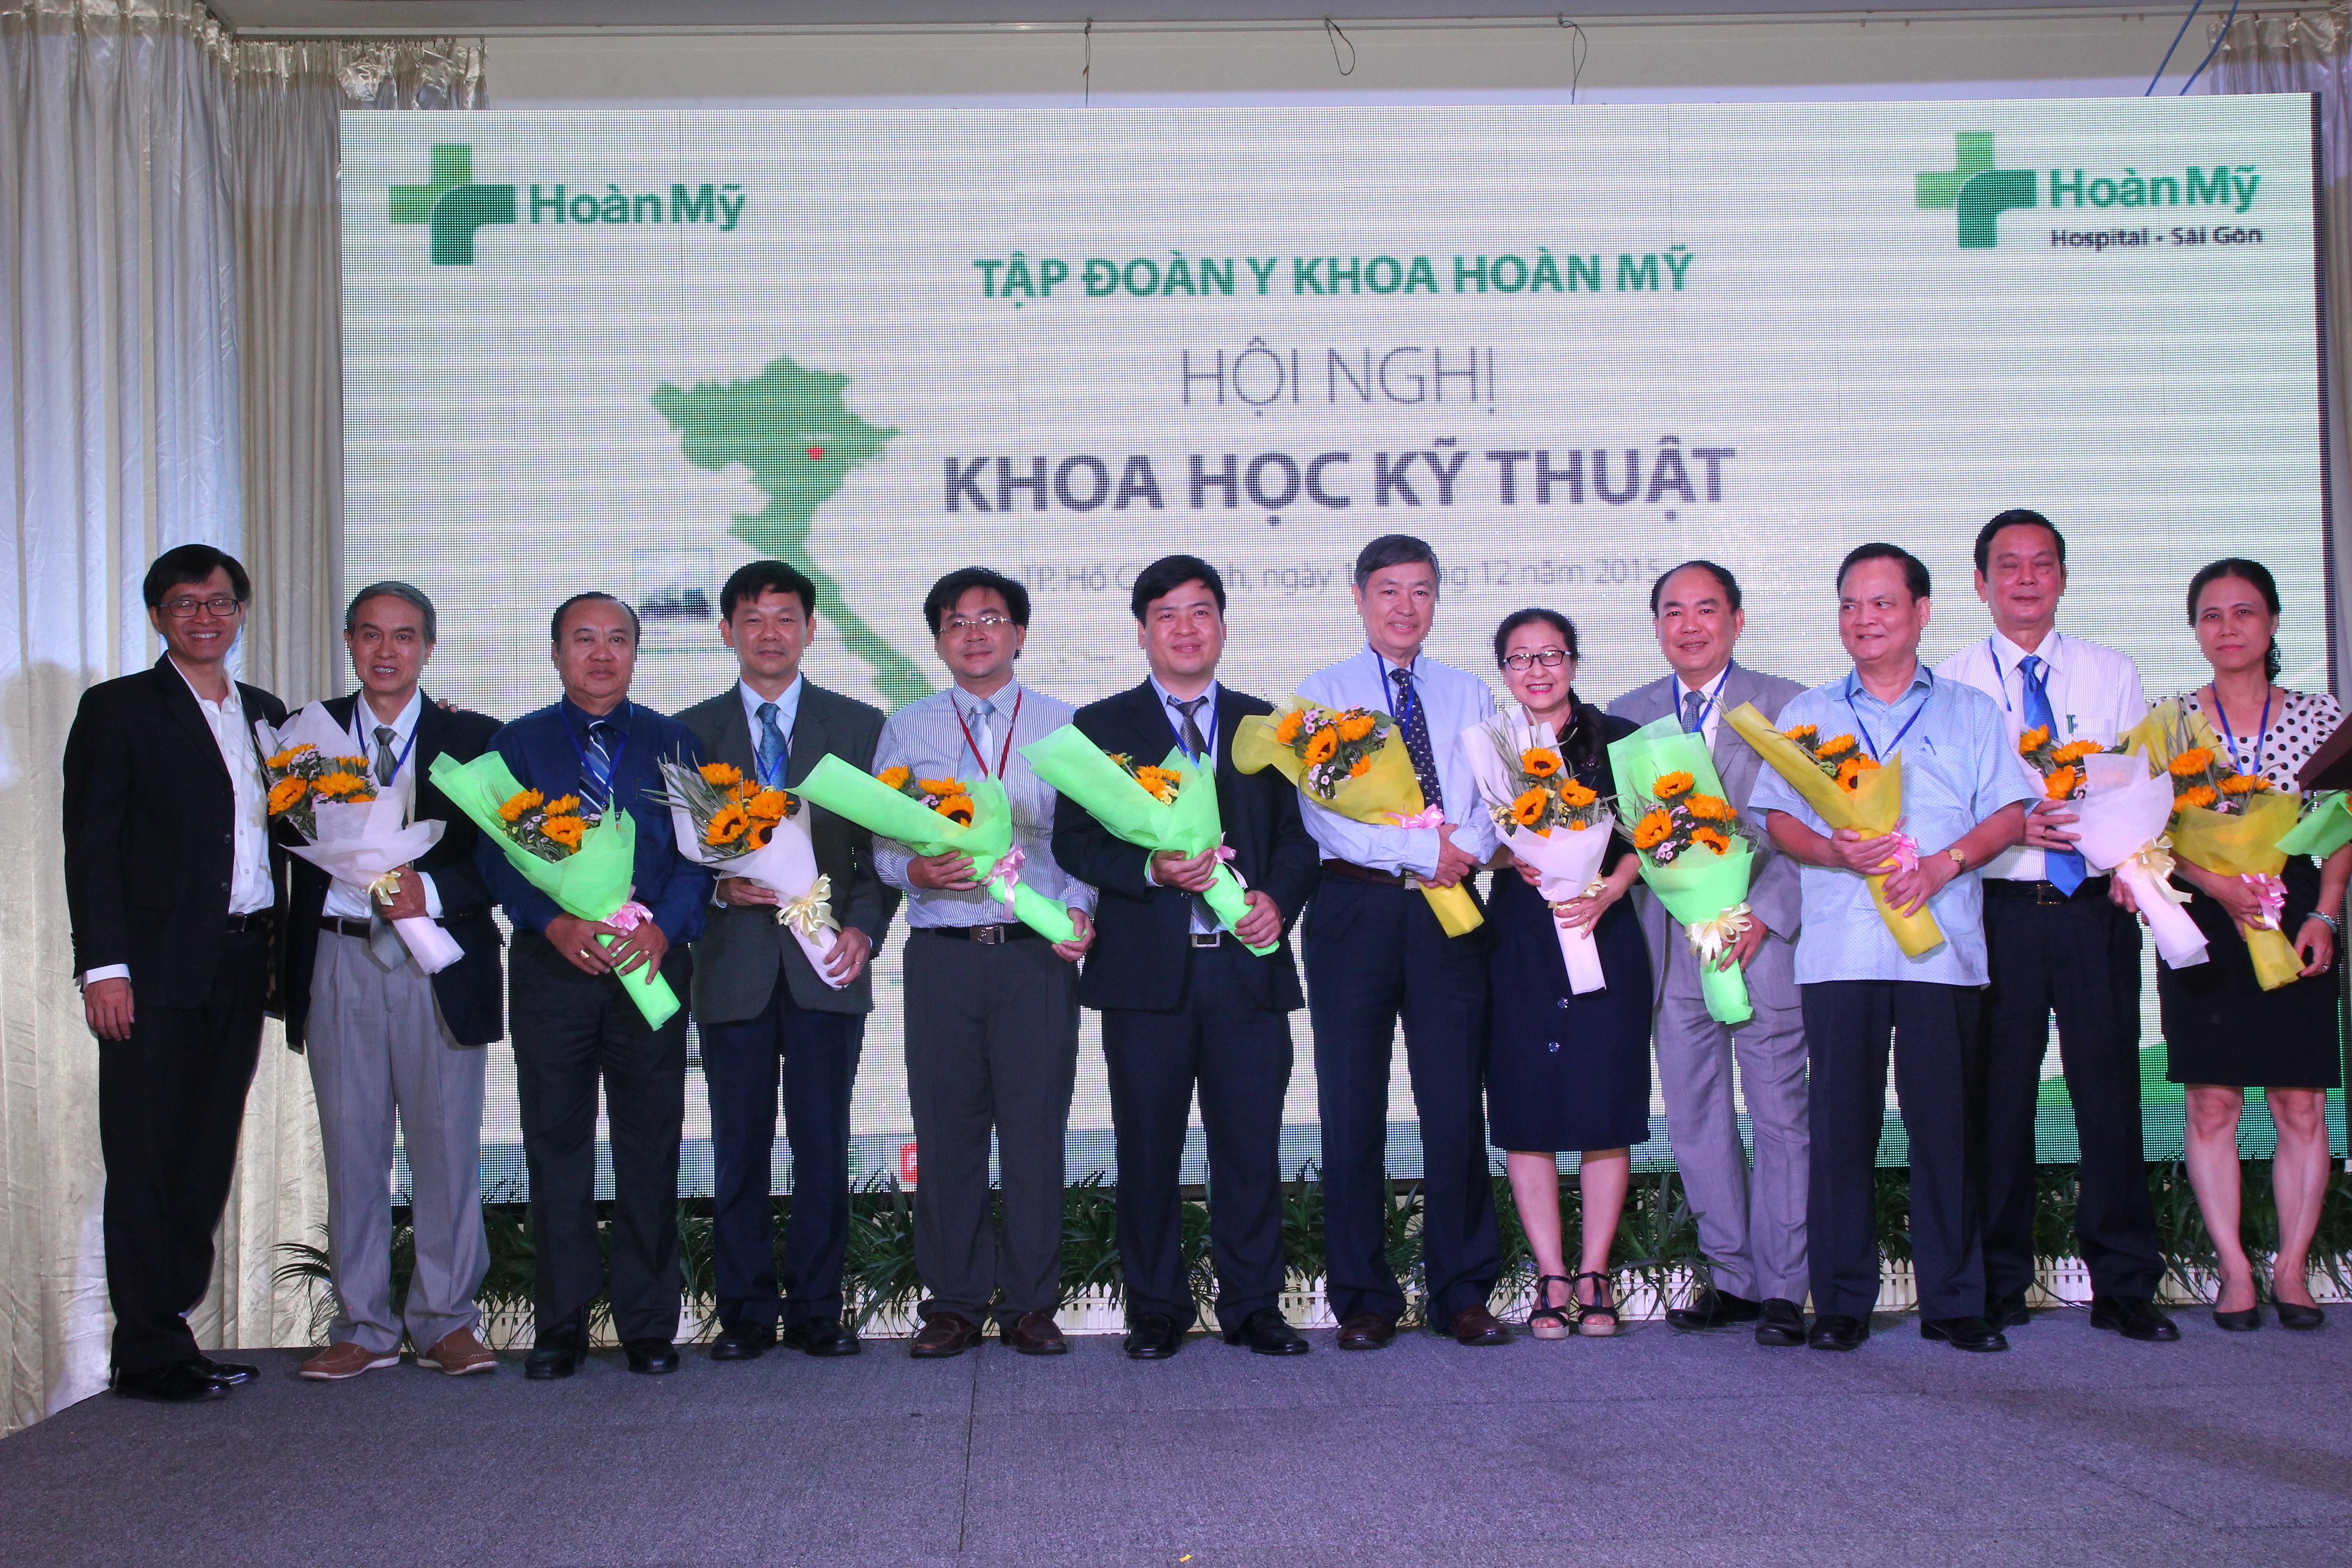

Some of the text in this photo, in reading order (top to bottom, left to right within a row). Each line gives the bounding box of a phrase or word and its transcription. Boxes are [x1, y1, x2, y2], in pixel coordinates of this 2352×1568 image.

[2051, 227, 2150, 252] Hospital
[973, 244, 1694, 308] TẬP ĐOÀN Y KHOA HOÀN MỸ
[1181, 335, 1496, 417] HỘI NGHỊ
[944, 435, 1736, 527] KHOA HỌC KỸ THUẬT
[1263, 562, 1332, 596] ngày
[1481, 560, 1512, 585] 12
[1595, 558, 1661, 585] 2015
